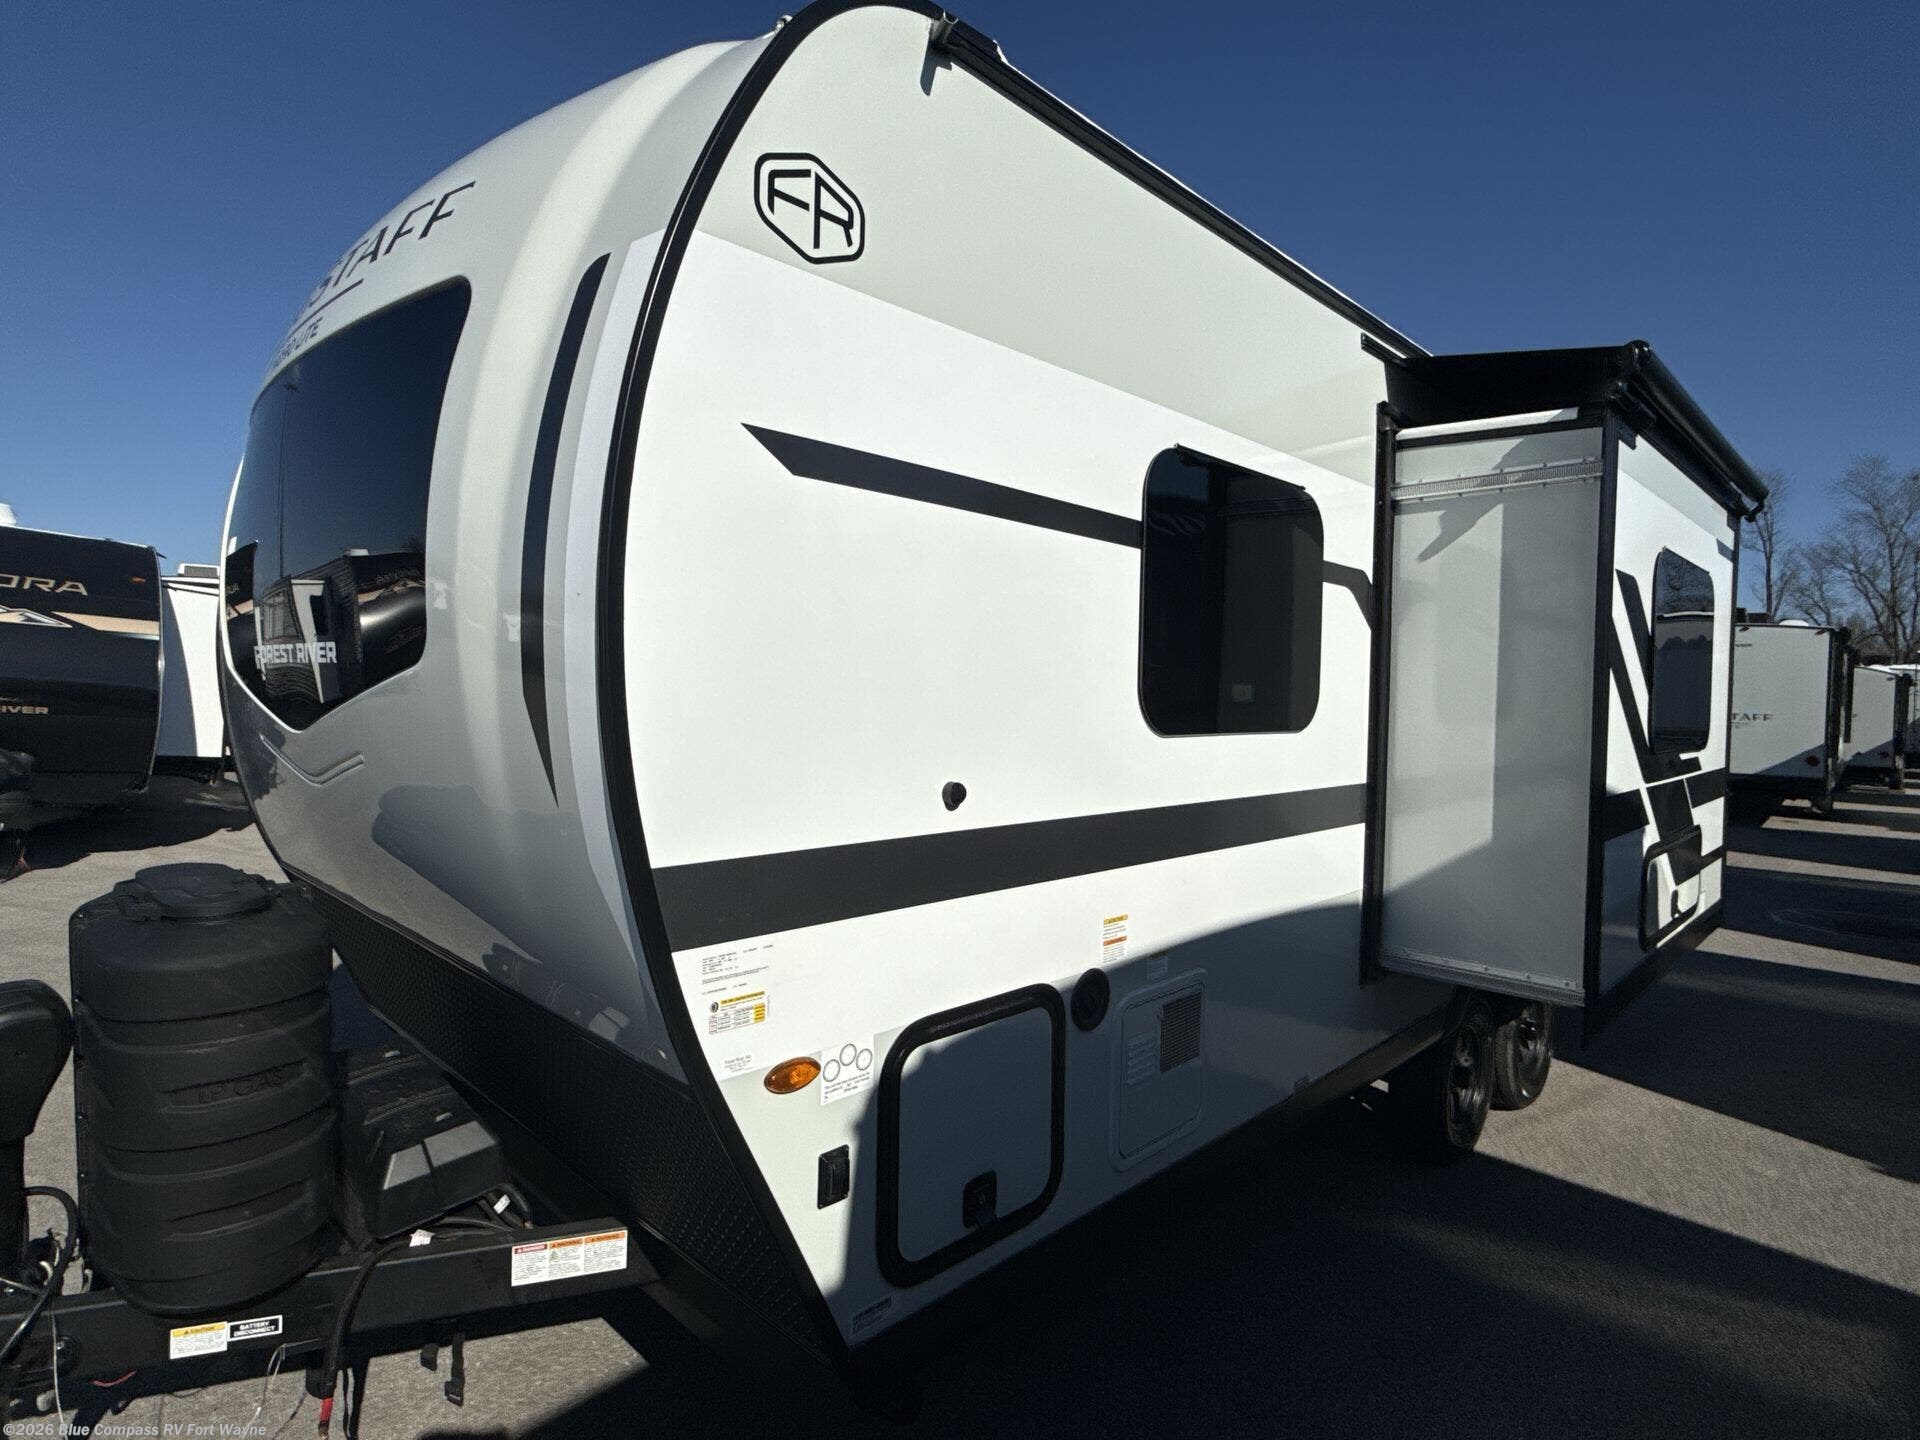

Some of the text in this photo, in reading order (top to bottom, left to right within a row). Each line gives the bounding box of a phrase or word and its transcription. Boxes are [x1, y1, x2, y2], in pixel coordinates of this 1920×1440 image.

[295, 641, 338, 664] RIVER
[0, 704, 49, 715] IVER
[233, 1325, 276, 1337] DISCONNECT
[239, 1320, 271, 1331] BATTERY
